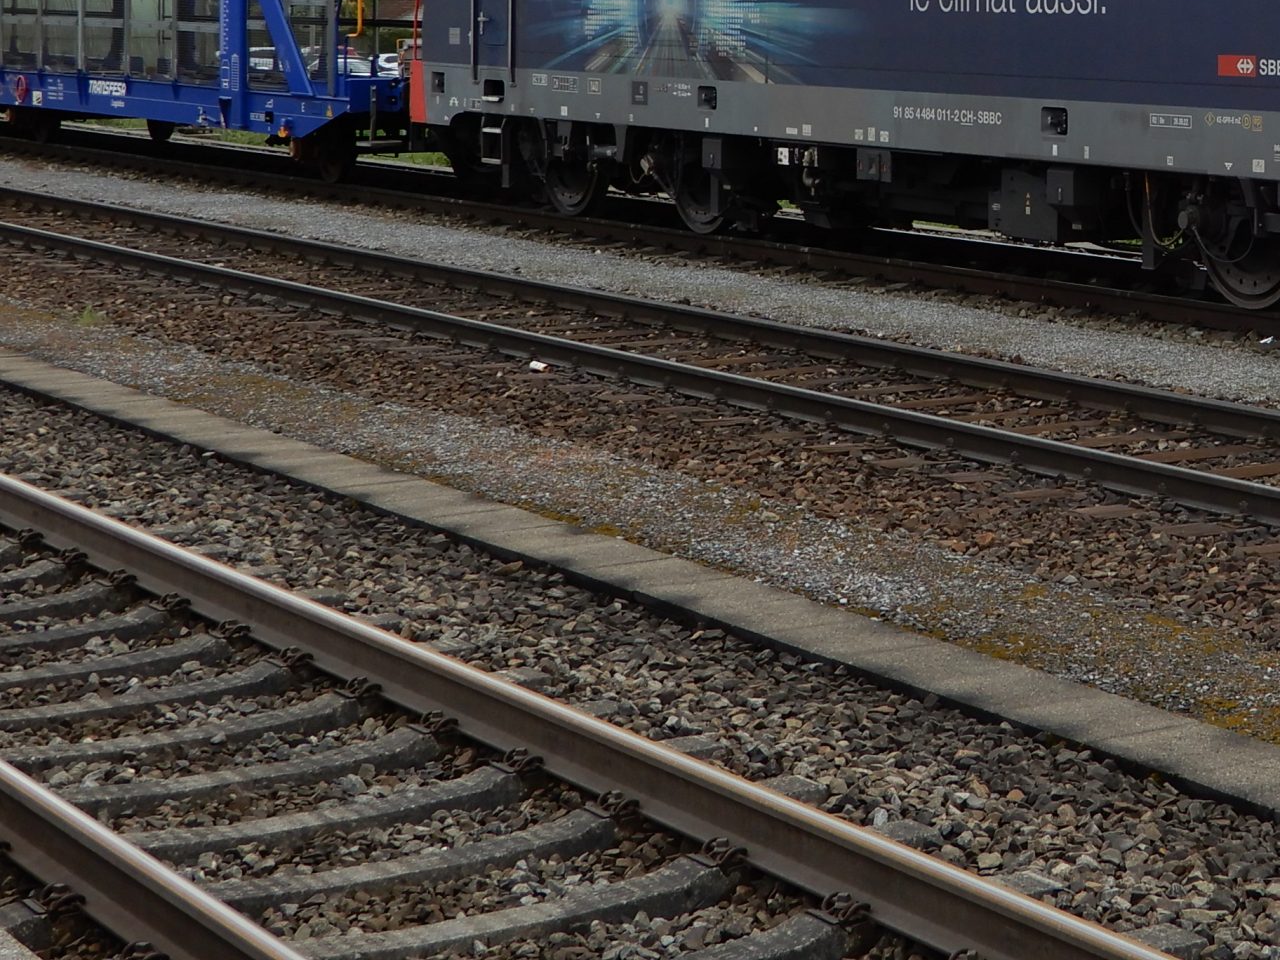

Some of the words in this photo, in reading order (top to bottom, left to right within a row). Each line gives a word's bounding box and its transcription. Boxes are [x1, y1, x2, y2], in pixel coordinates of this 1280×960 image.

[88, 79, 127, 97] TRANSFESA
[893, 105, 903, 119] 91
[904, 106, 915, 120] 85
[937, 108, 960, 122] 011-2
